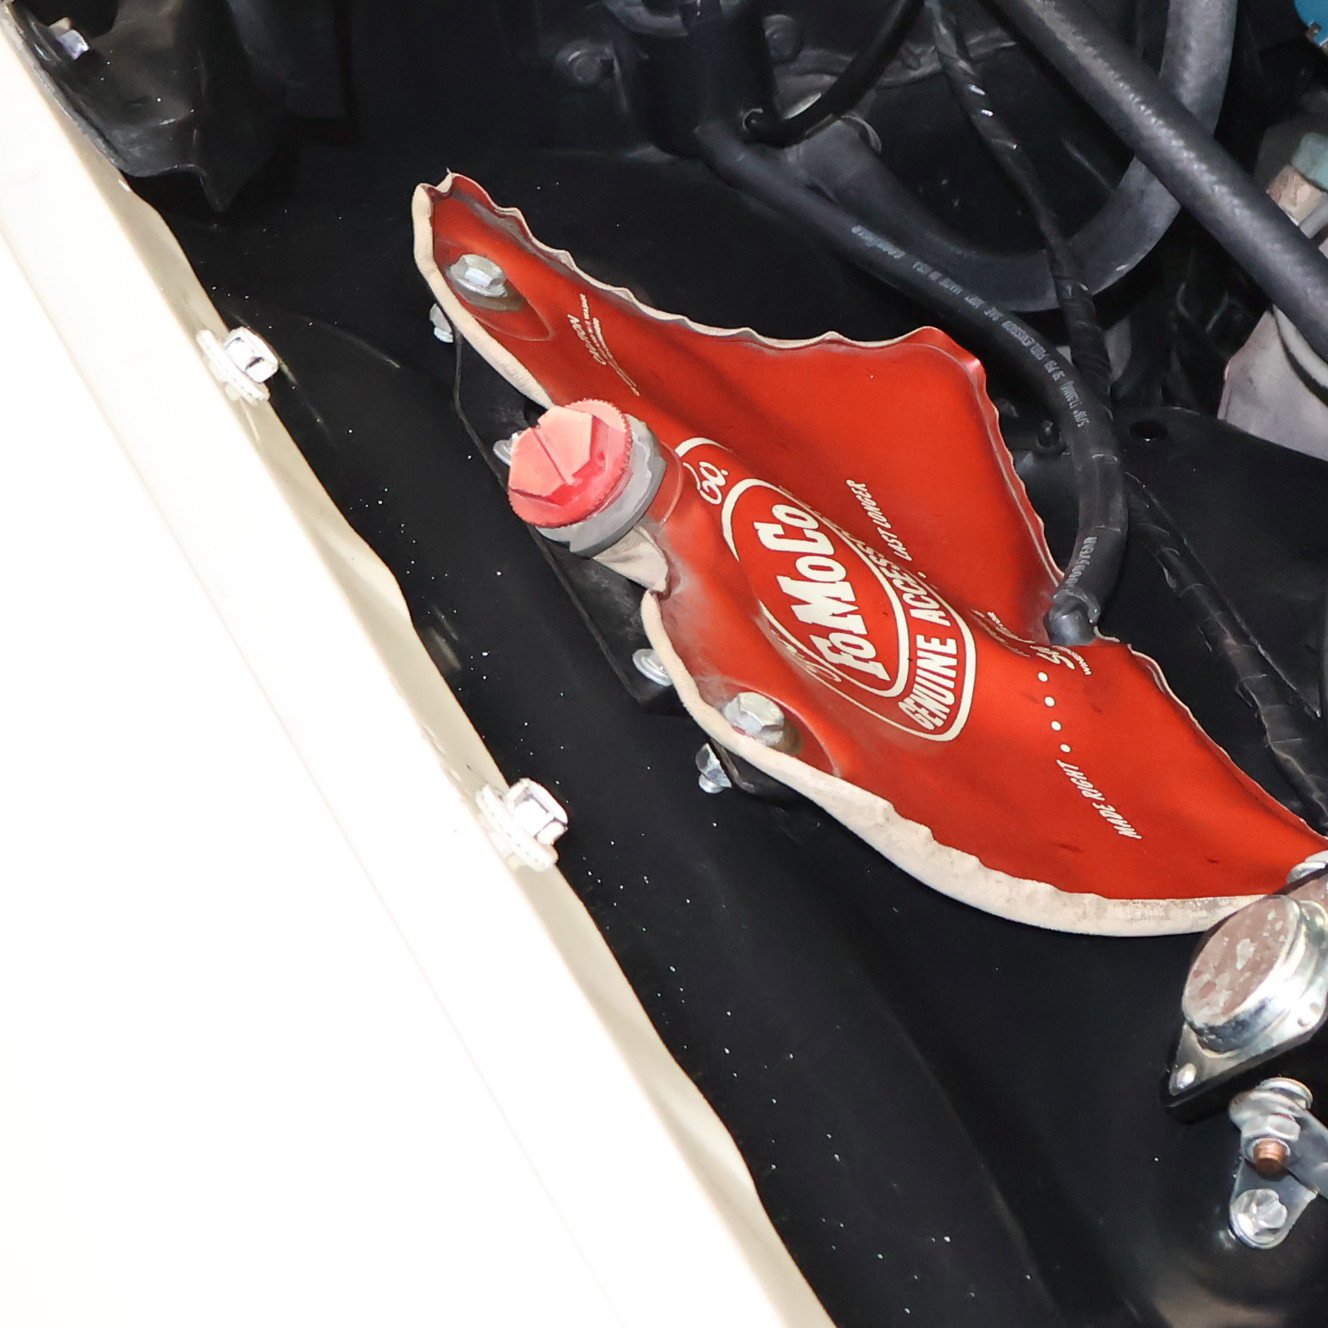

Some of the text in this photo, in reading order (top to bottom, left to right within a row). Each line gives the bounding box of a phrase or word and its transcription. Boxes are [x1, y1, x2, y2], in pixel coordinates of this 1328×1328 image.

[847, 480, 912, 559] LAST LONGER
[758, 502, 890, 681] FoMoCo
[897, 634, 956, 729] GENUINE
[1057, 759, 1142, 840] MADE RIGHT
